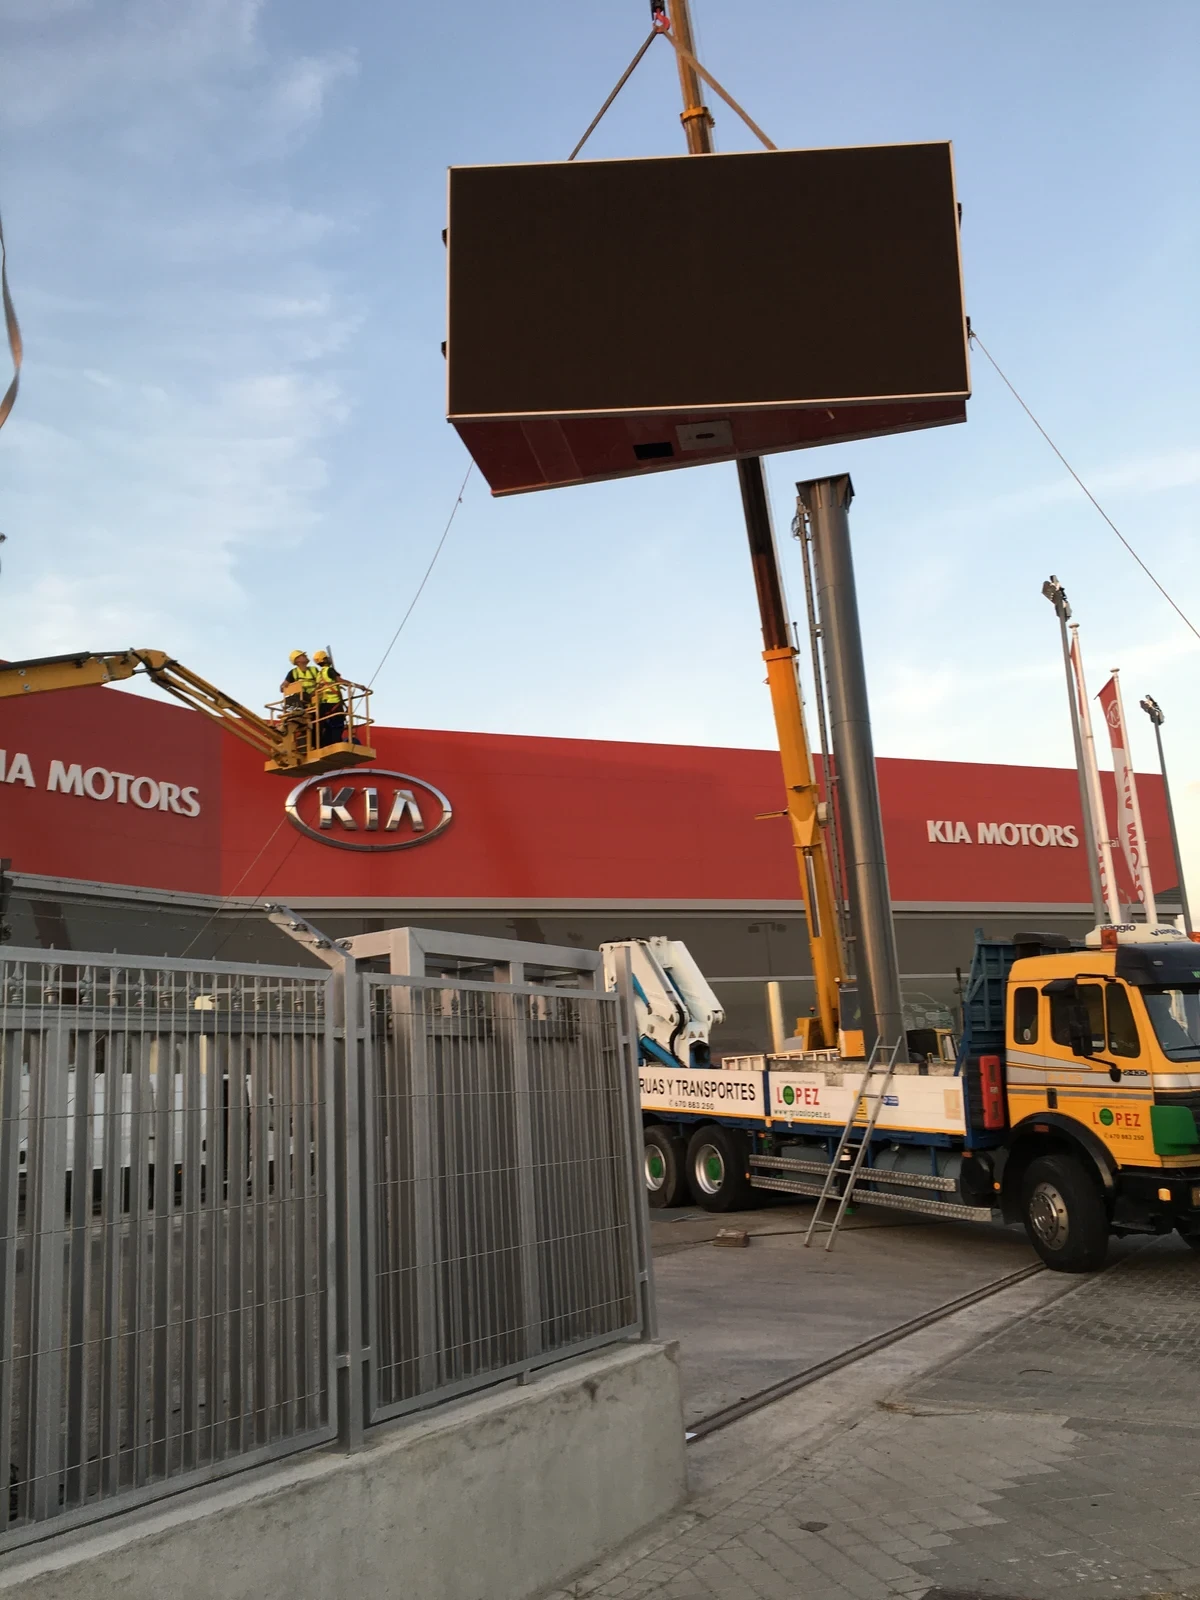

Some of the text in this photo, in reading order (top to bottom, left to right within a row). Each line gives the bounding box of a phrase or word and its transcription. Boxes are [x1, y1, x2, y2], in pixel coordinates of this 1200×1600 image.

[0, 749, 200, 817] IA MOTORS
[317, 786, 424, 832] KIA
[927, 820, 973, 844] KIA
[977, 822, 1079, 848] MOTORS
[639, 1078, 756, 1101] RUAS Y TRANSPORTES
[701, 1102, 715, 1110] 250
